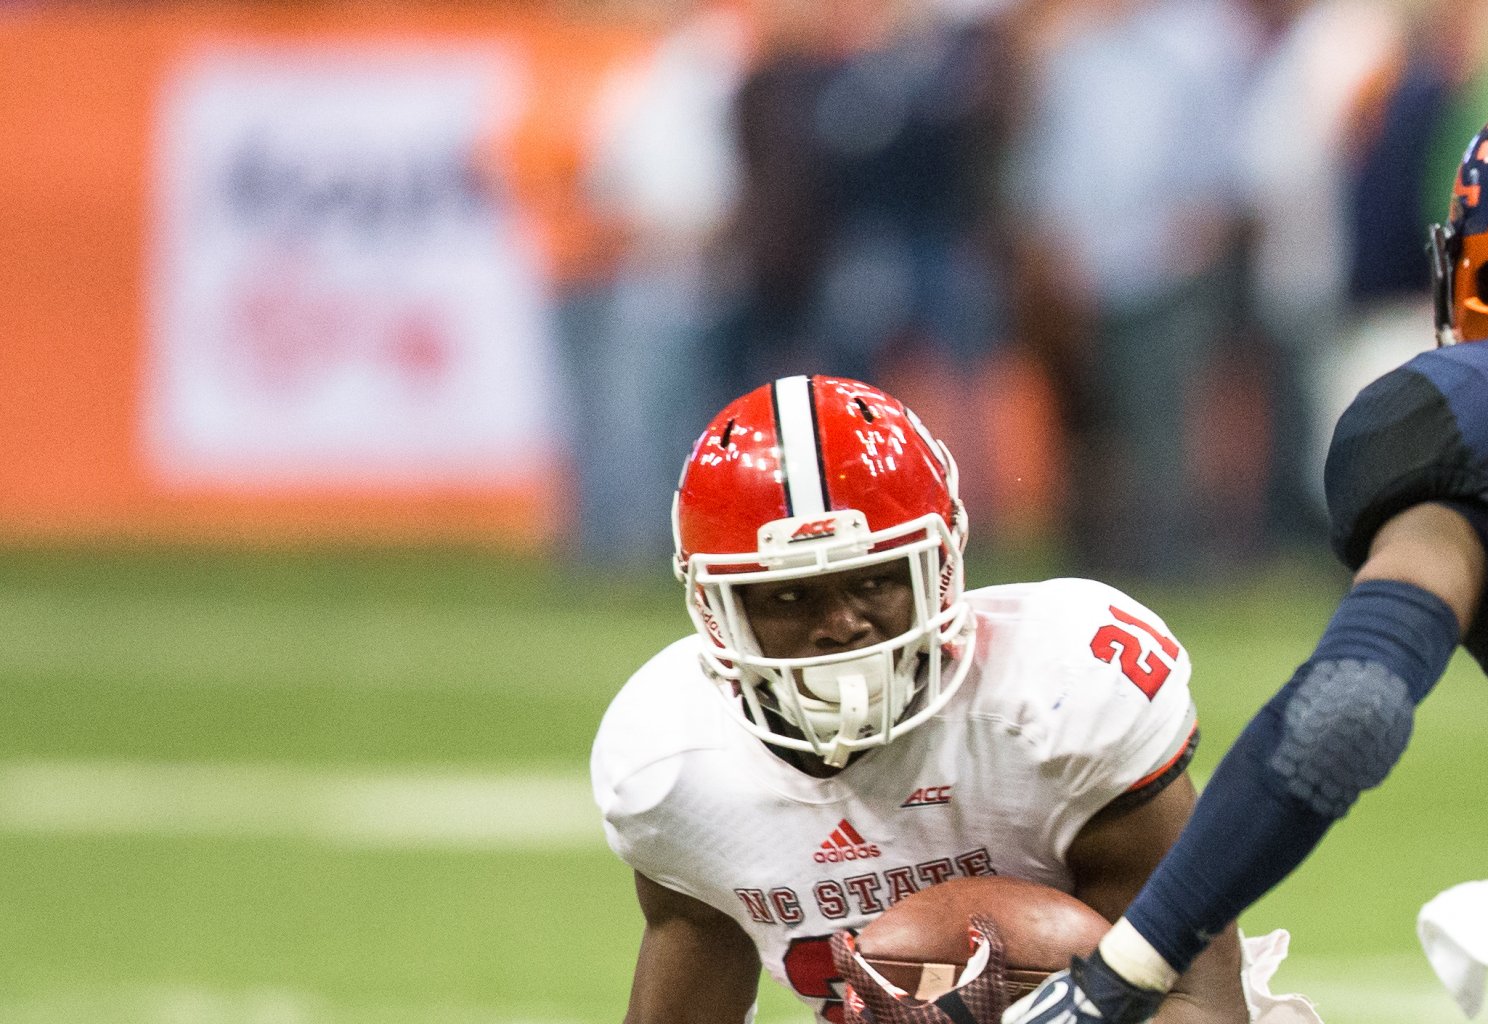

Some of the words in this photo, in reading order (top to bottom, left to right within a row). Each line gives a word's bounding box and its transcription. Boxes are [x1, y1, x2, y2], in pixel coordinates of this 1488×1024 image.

[789, 518, 837, 541] ACC
[1089, 604, 1180, 703] 21
[903, 785, 953, 806] ACC
[813, 843, 881, 863] adidas
[734, 887, 805, 925] NC
